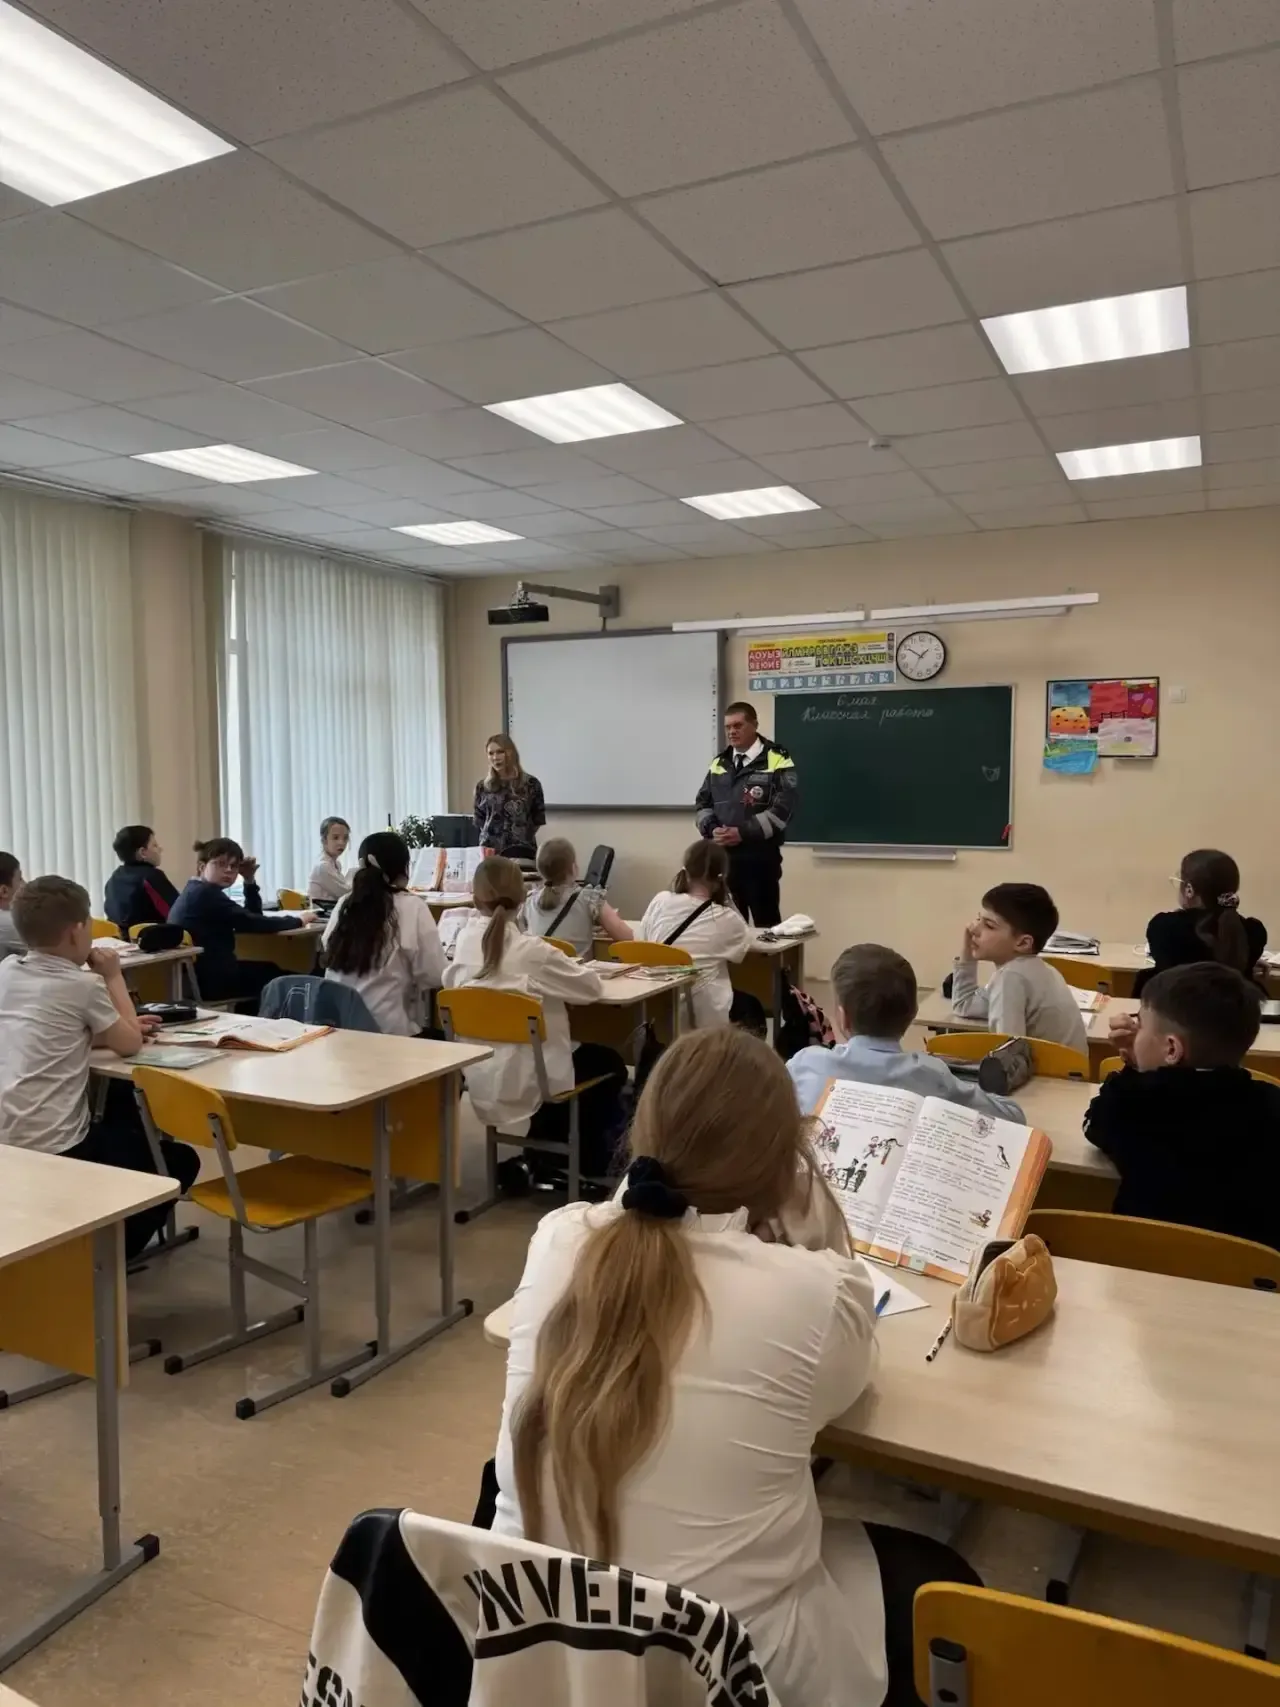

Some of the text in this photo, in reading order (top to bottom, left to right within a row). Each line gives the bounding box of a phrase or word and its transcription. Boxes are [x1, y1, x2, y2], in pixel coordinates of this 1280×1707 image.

[848, 695, 878, 706] мая
[801, 705, 934, 727] Классная работа
